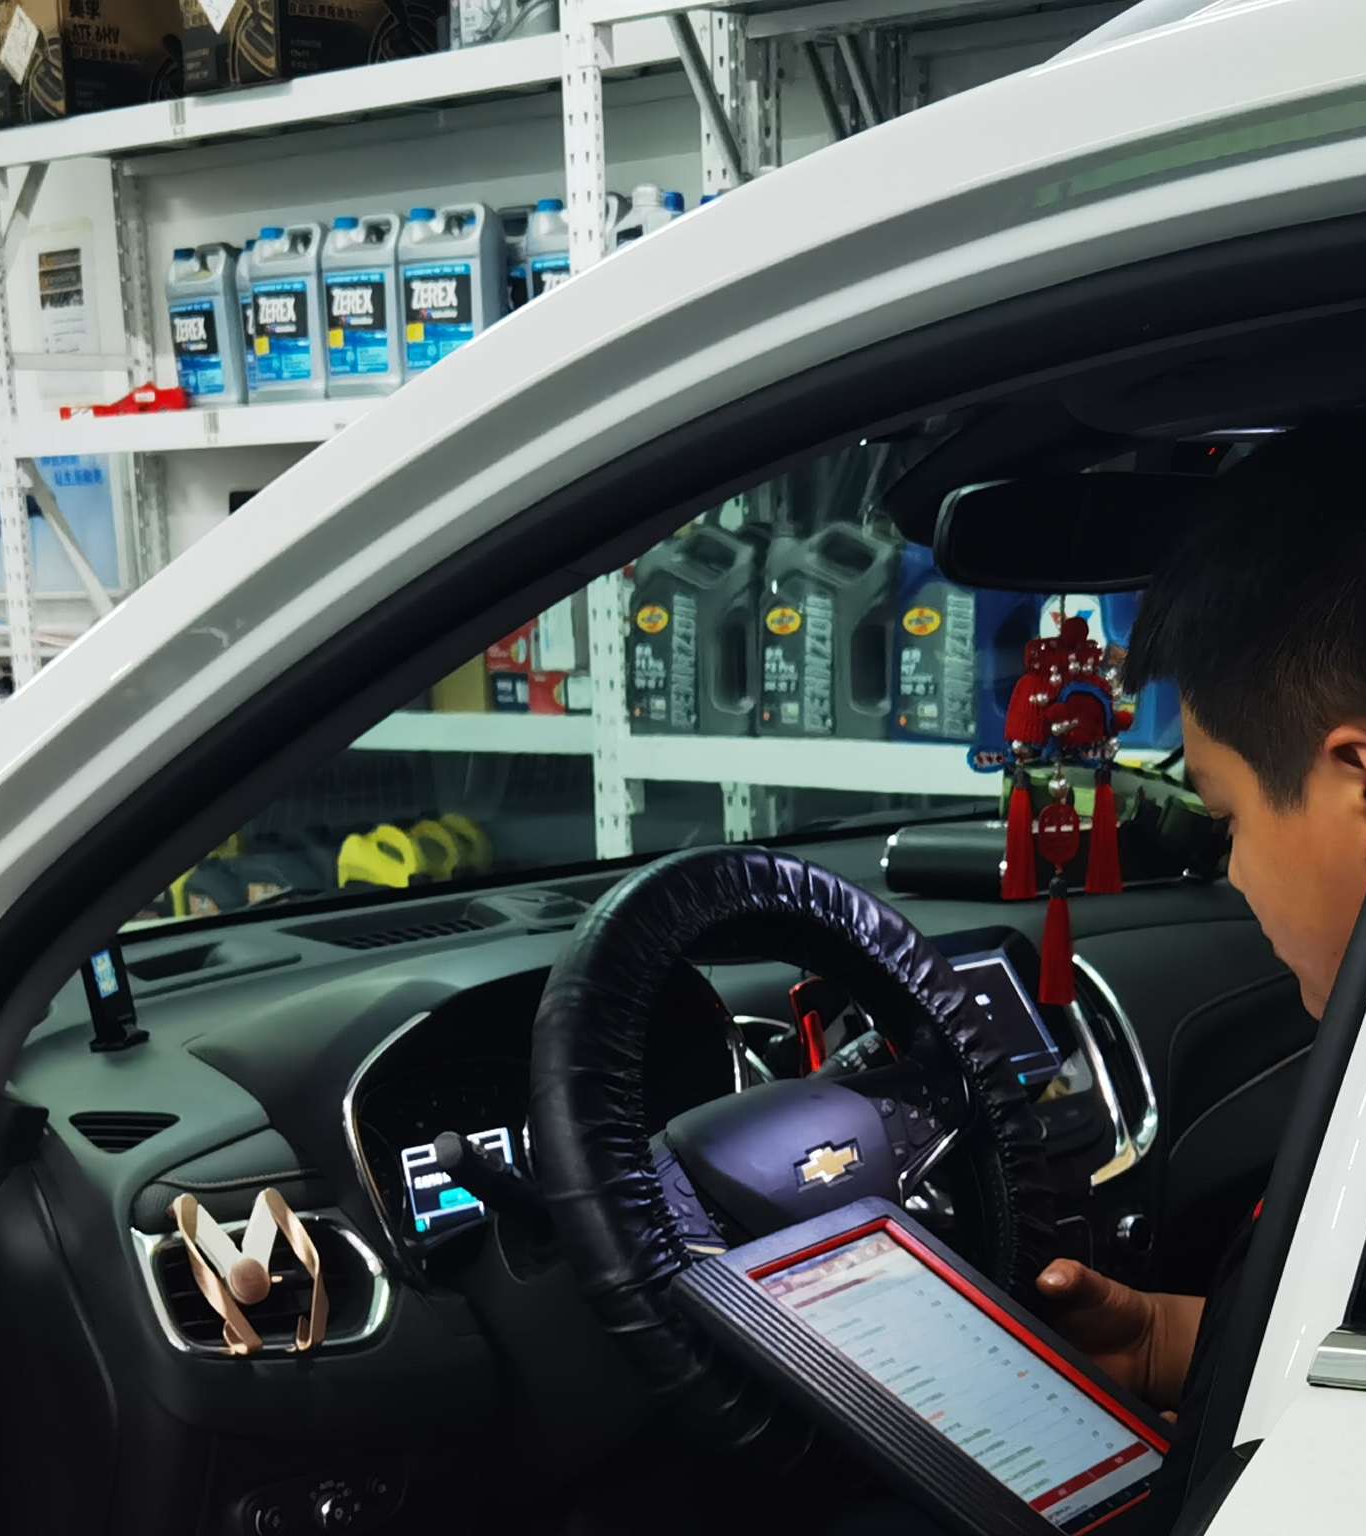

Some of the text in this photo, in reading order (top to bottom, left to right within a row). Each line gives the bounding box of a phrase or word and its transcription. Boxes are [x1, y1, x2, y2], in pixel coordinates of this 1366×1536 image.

[330, 286, 374, 316] ZEREX
[410, 279, 459, 310] ZEREX
[257, 295, 297, 324] ZEREX
[173, 316, 207, 343] ZEREX
